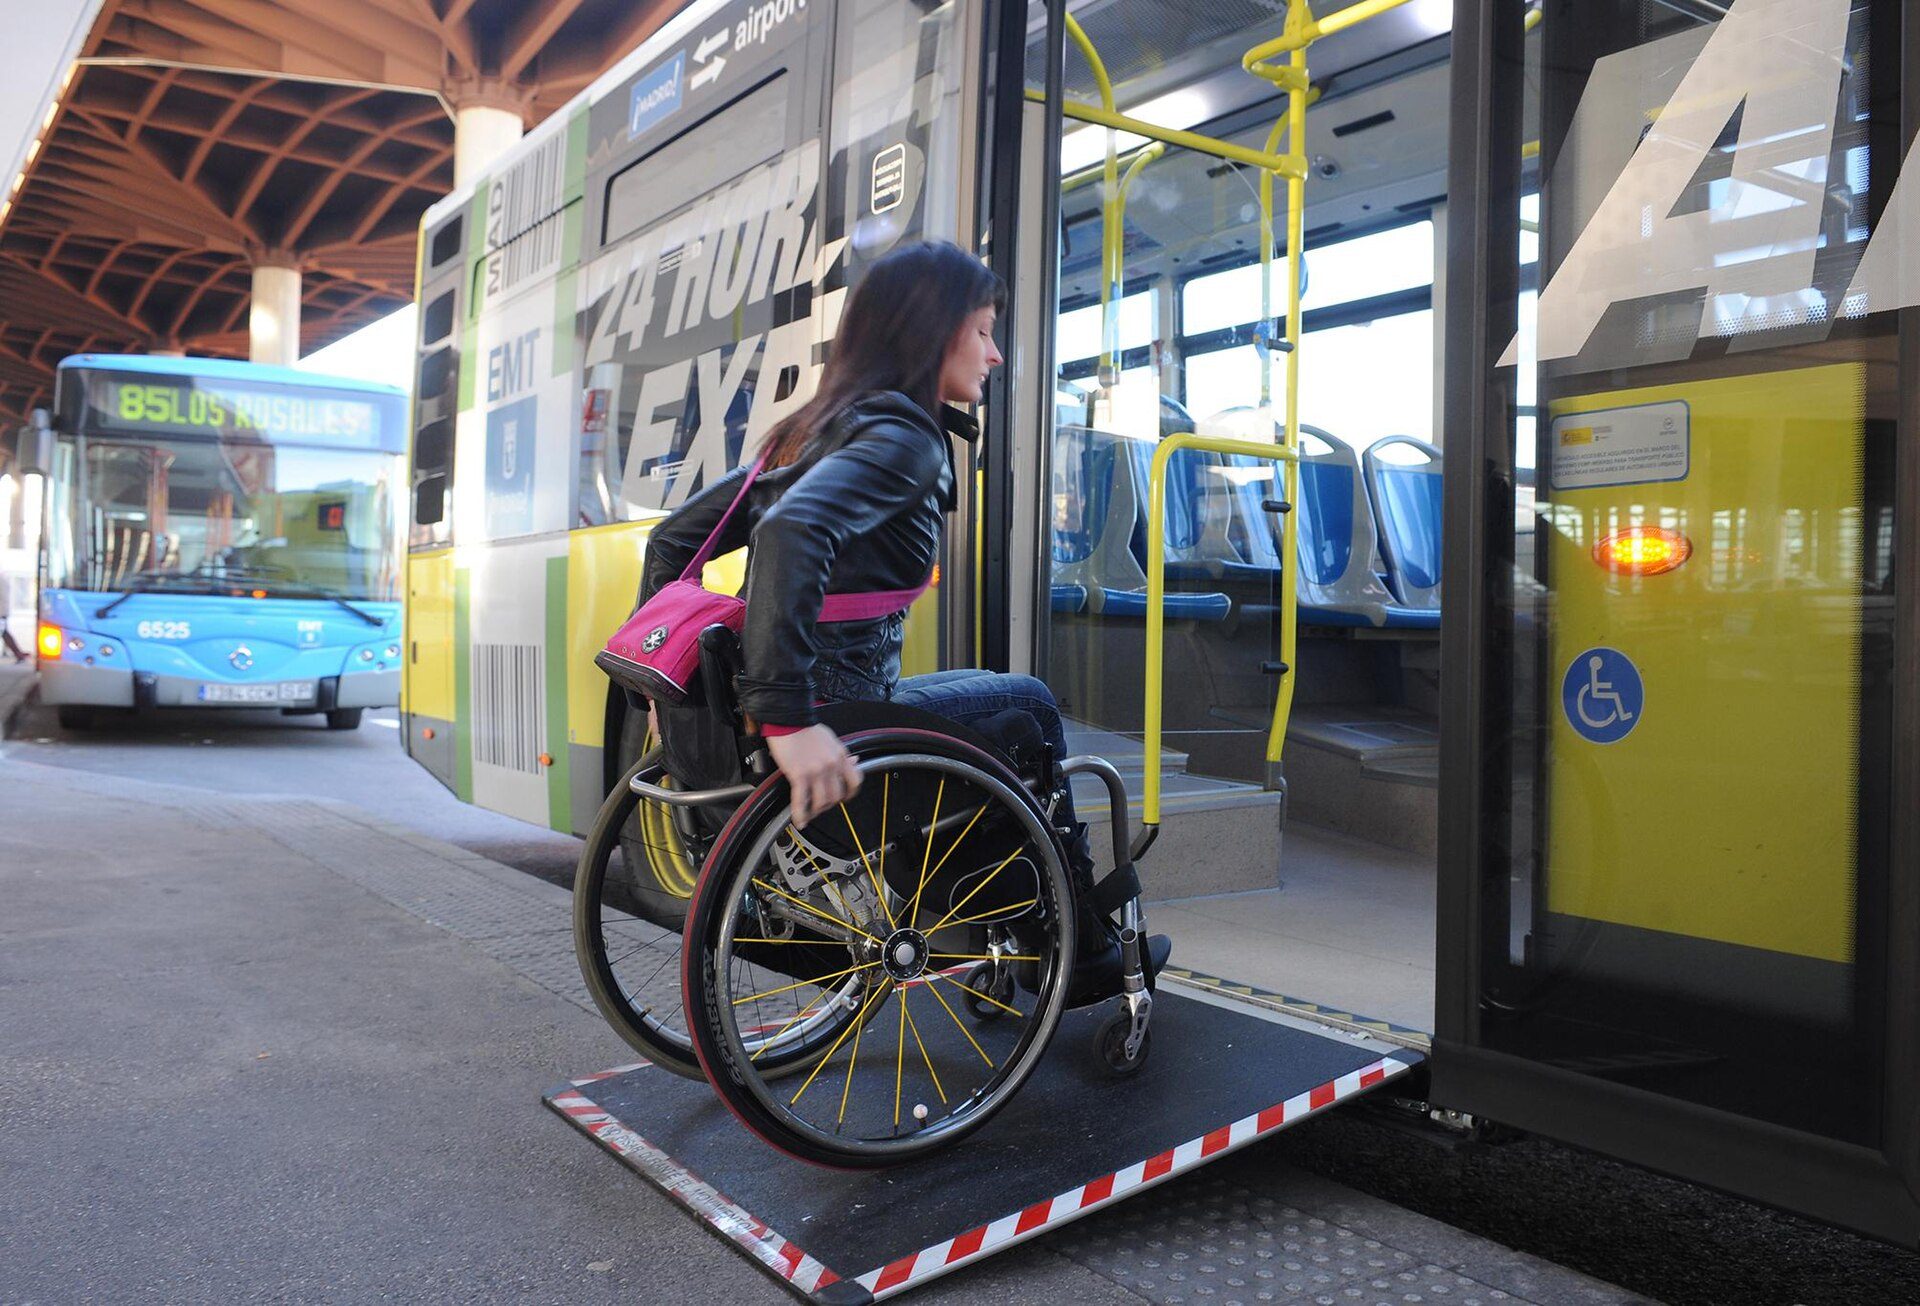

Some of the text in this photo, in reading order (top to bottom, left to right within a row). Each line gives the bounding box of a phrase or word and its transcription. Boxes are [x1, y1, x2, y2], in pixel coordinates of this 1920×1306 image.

[487, 328, 540, 402] EMT
[118, 384, 171, 423] 85
[171, 387, 226, 427] LOS
[137, 620, 192, 640] 6525
